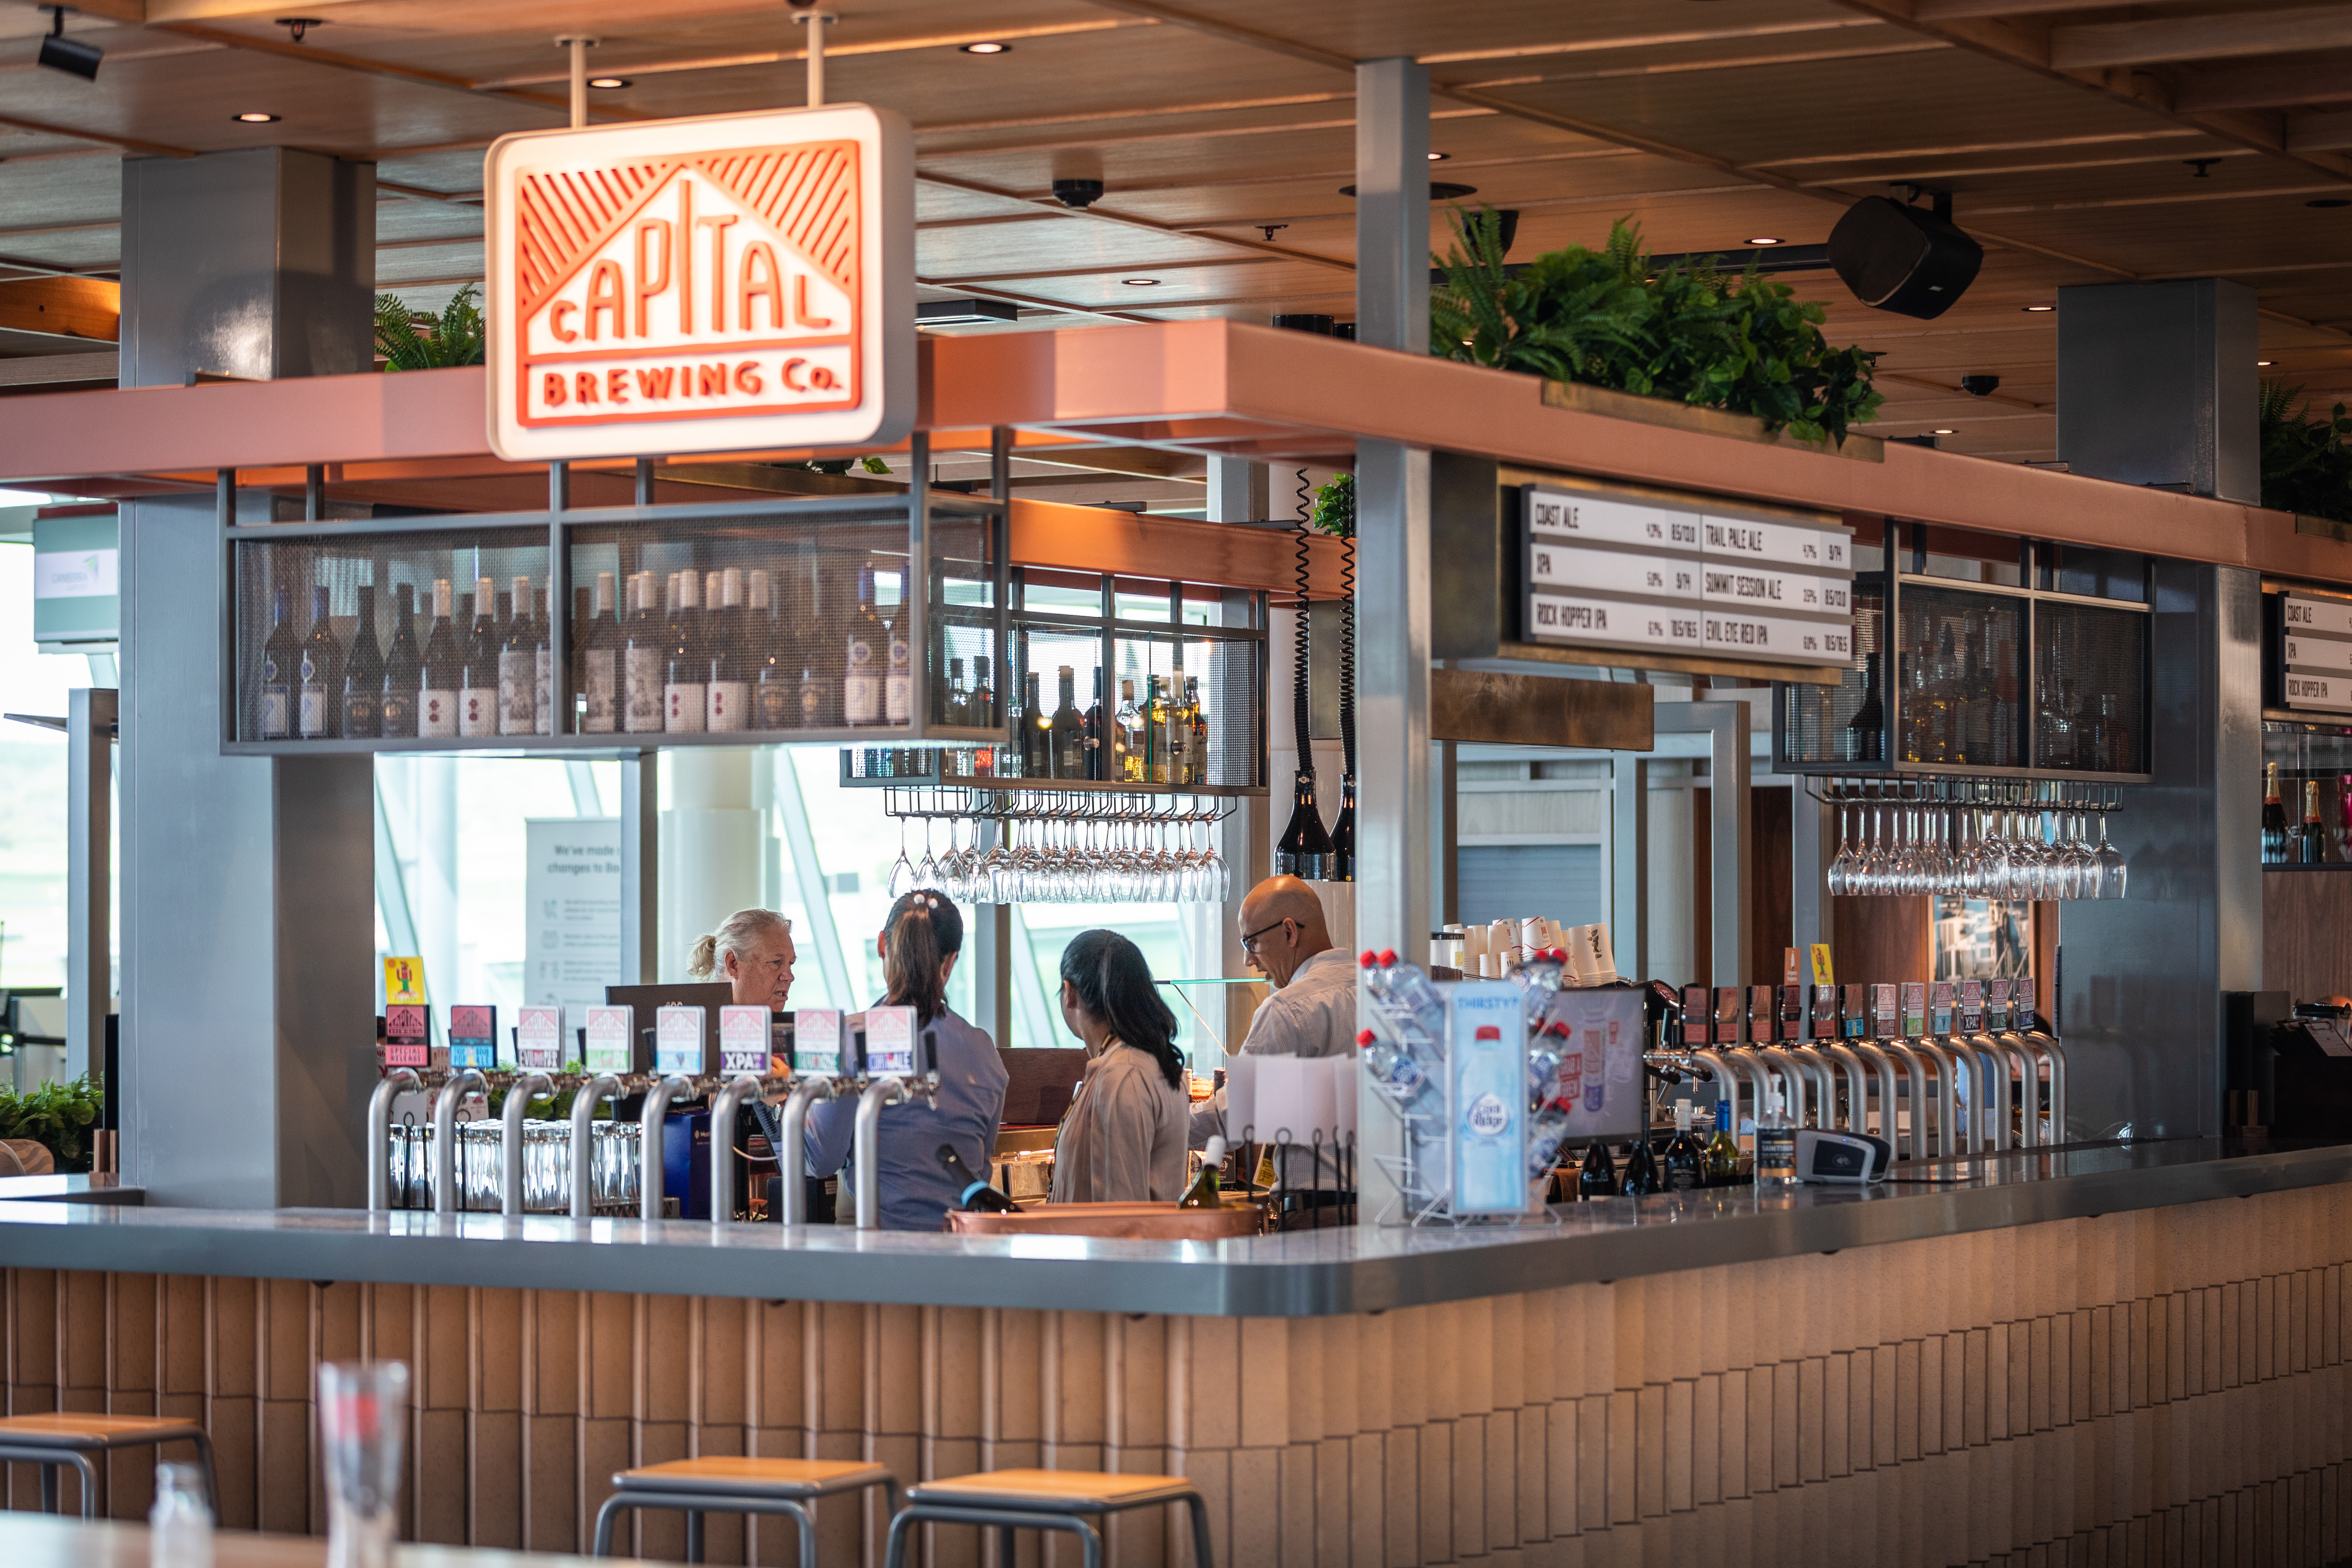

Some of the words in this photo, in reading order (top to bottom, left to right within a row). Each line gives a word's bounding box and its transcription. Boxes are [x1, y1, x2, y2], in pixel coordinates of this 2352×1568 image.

[550, 179, 832, 343] CAPITAL
[543, 361, 763, 406] BREWING
[1536, 504, 1560, 526] COAST
[1563, 506, 1579, 529] ALE
[1706, 525, 1726, 547] TRAIL
[1729, 527, 1746, 550] PALE
[1748, 530, 1762, 551] ALE
[1537, 553, 1552, 574] XPA
[1706, 572, 1734, 595] SUMMIT
[1737, 575, 1766, 599] SESSION
[1768, 579, 1782, 600] ALE
[1537, 603, 1558, 626] ROCK
[1561, 605, 1592, 628] HOPPER
[1594, 609, 1608, 630] IPA
[2287, 604, 2302, 622] COAST
[2303, 607, 2312, 624] ALE
[1706, 620, 1723, 642] EVIL
[1725, 622, 1739, 643] EYE
[1741, 623, 1755, 644] RED
[1757, 625, 1769, 646] IPA
[2288, 642, 2296, 659] XPA
[2288, 679, 2300, 696] ROCK
[2302, 680, 2319, 698] HOPPER
[1965, 1016, 1977, 1029] XPA
[725, 1053, 754, 1070] XPA
